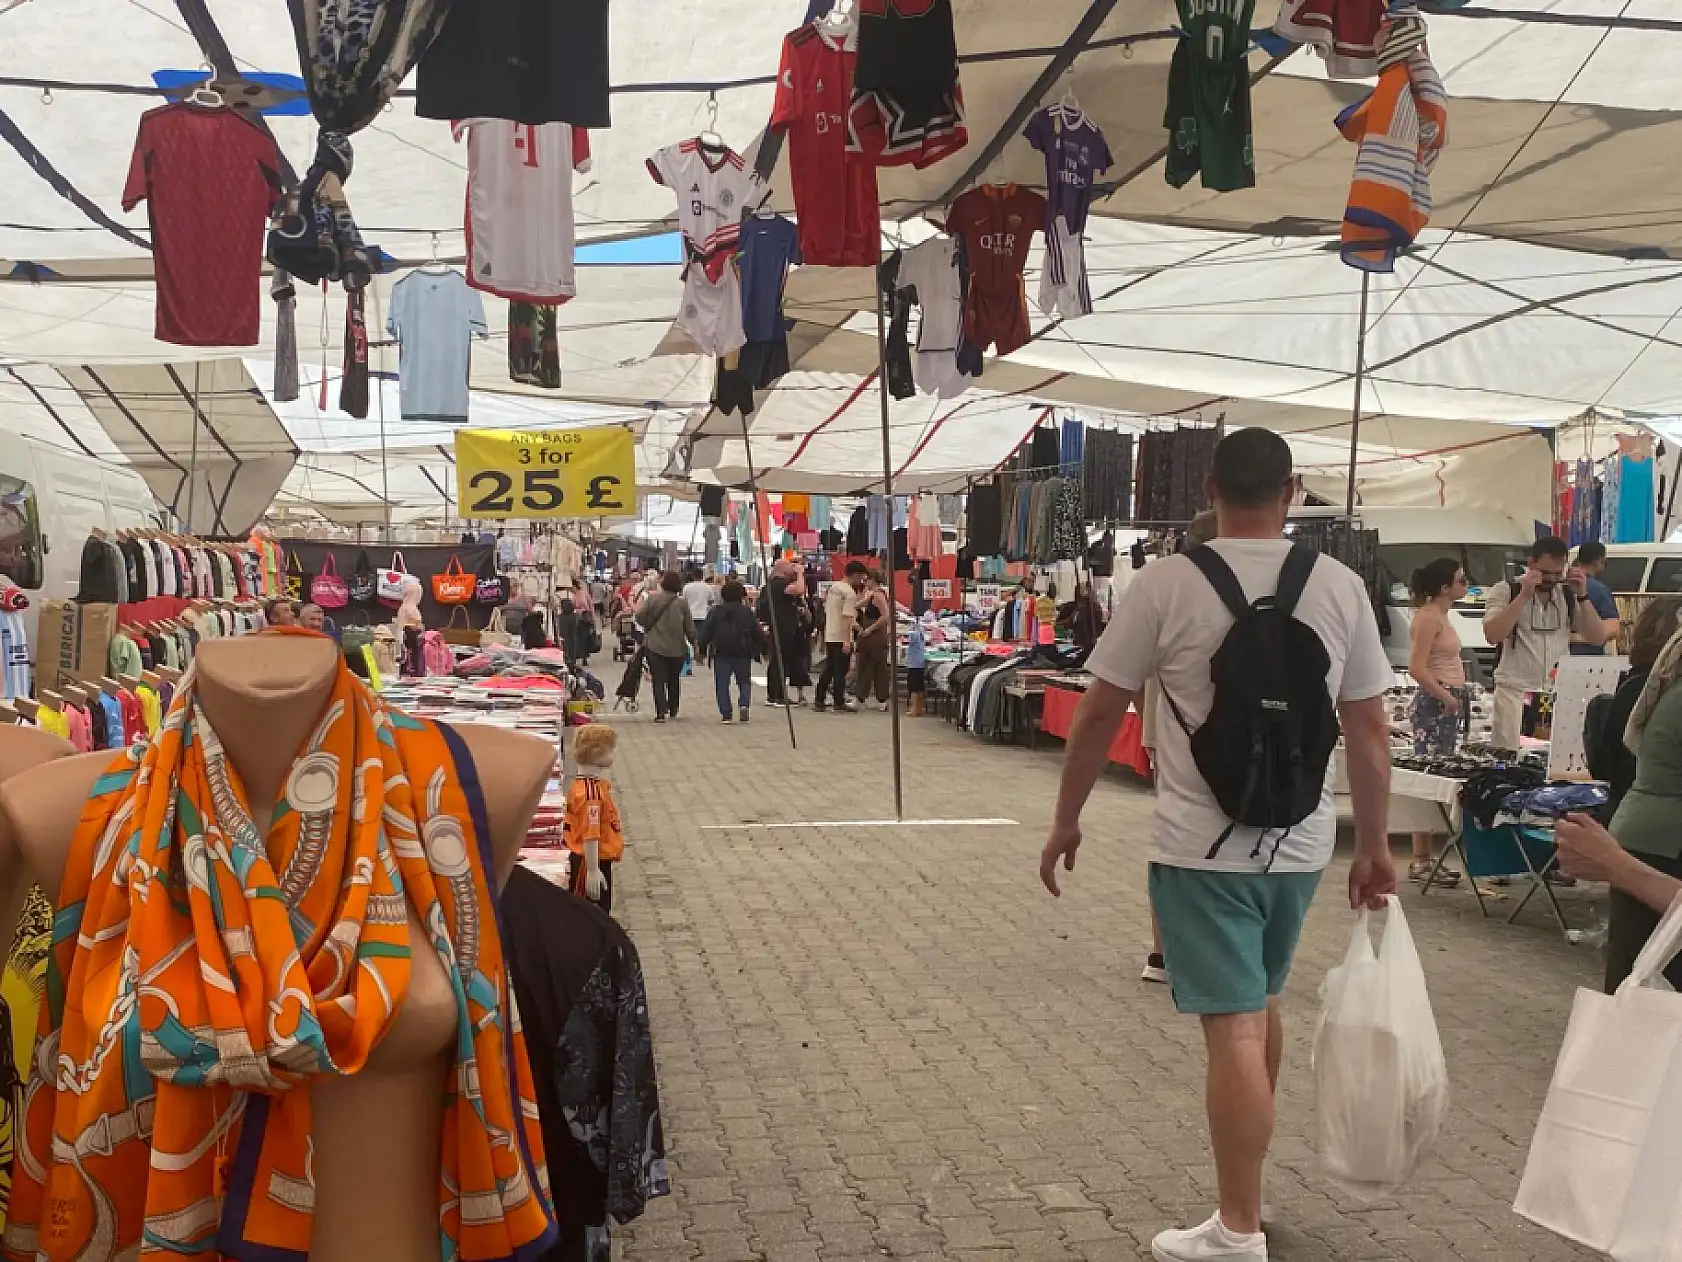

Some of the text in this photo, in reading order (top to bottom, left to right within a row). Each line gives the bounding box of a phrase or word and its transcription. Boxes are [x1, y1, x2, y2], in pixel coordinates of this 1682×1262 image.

[510, 433, 583, 444] ANY BAGS
[518, 447, 574, 464] 3 for
[469, 469, 623, 512] 25 £
